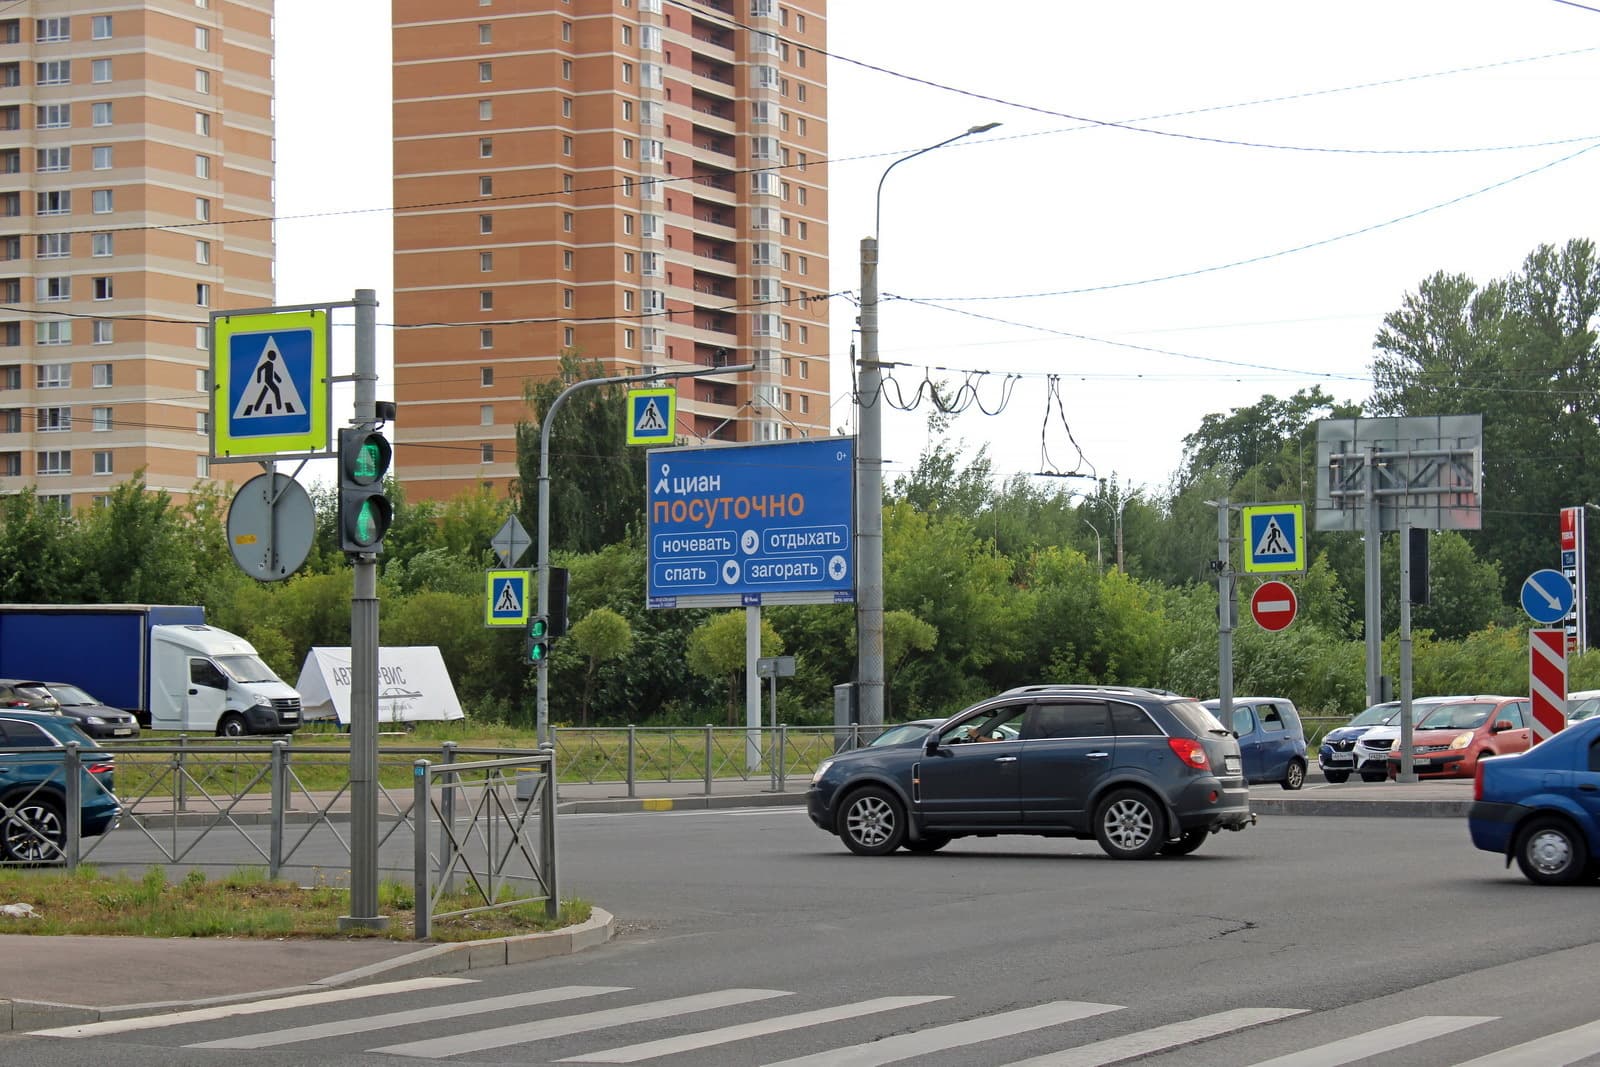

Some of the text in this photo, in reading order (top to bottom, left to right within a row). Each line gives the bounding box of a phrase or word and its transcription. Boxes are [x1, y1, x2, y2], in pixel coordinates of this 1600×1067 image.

[836, 451, 848, 461] 0+
[673, 474, 721, 496] циан
[653, 492, 805, 529] посуточно
[662, 536, 731, 553] ночевать
[770, 530, 840, 550] отдыхать
[664, 566, 707, 581] спать
[751, 561, 818, 582] загорать
